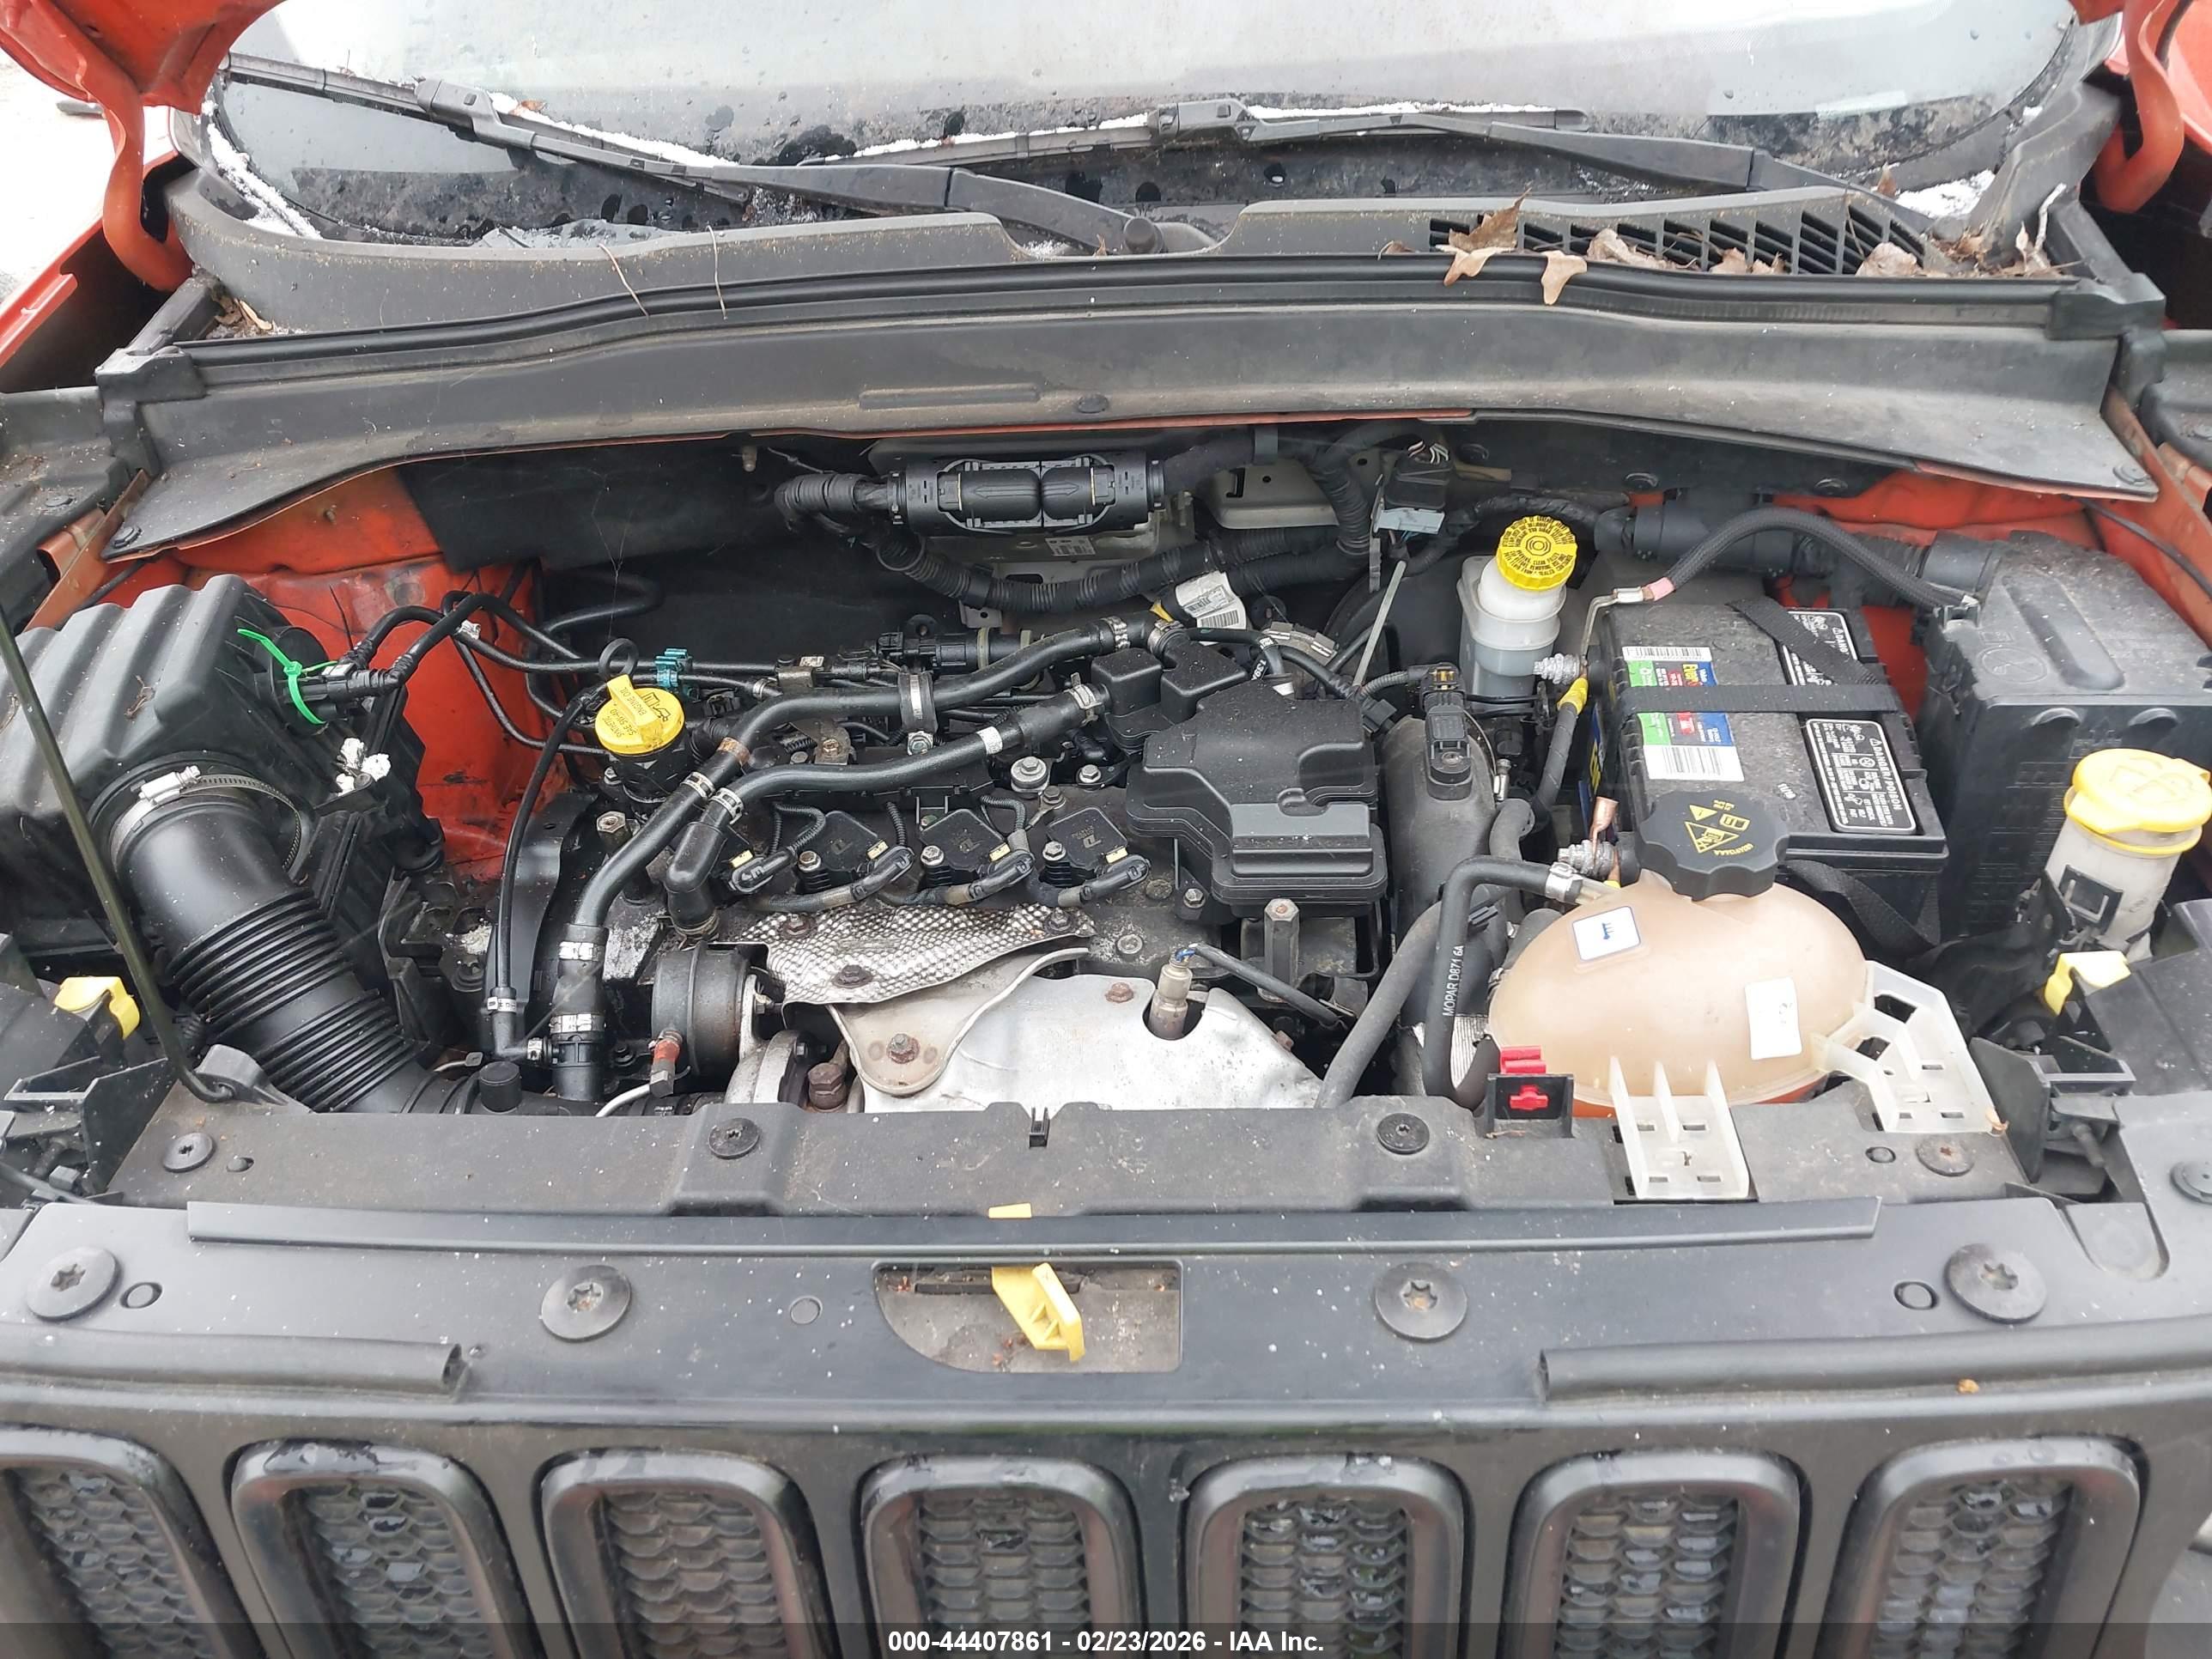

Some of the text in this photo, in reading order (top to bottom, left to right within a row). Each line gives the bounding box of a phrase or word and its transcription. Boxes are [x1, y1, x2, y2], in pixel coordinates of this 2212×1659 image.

[619, 686, 647, 716] ENGINE OIL
[623, 725, 637, 736] SAE
[1874, 746, 1903, 811] DANGER/POISON
[1442, 945, 1465, 1017] MOPAR D871 6A
